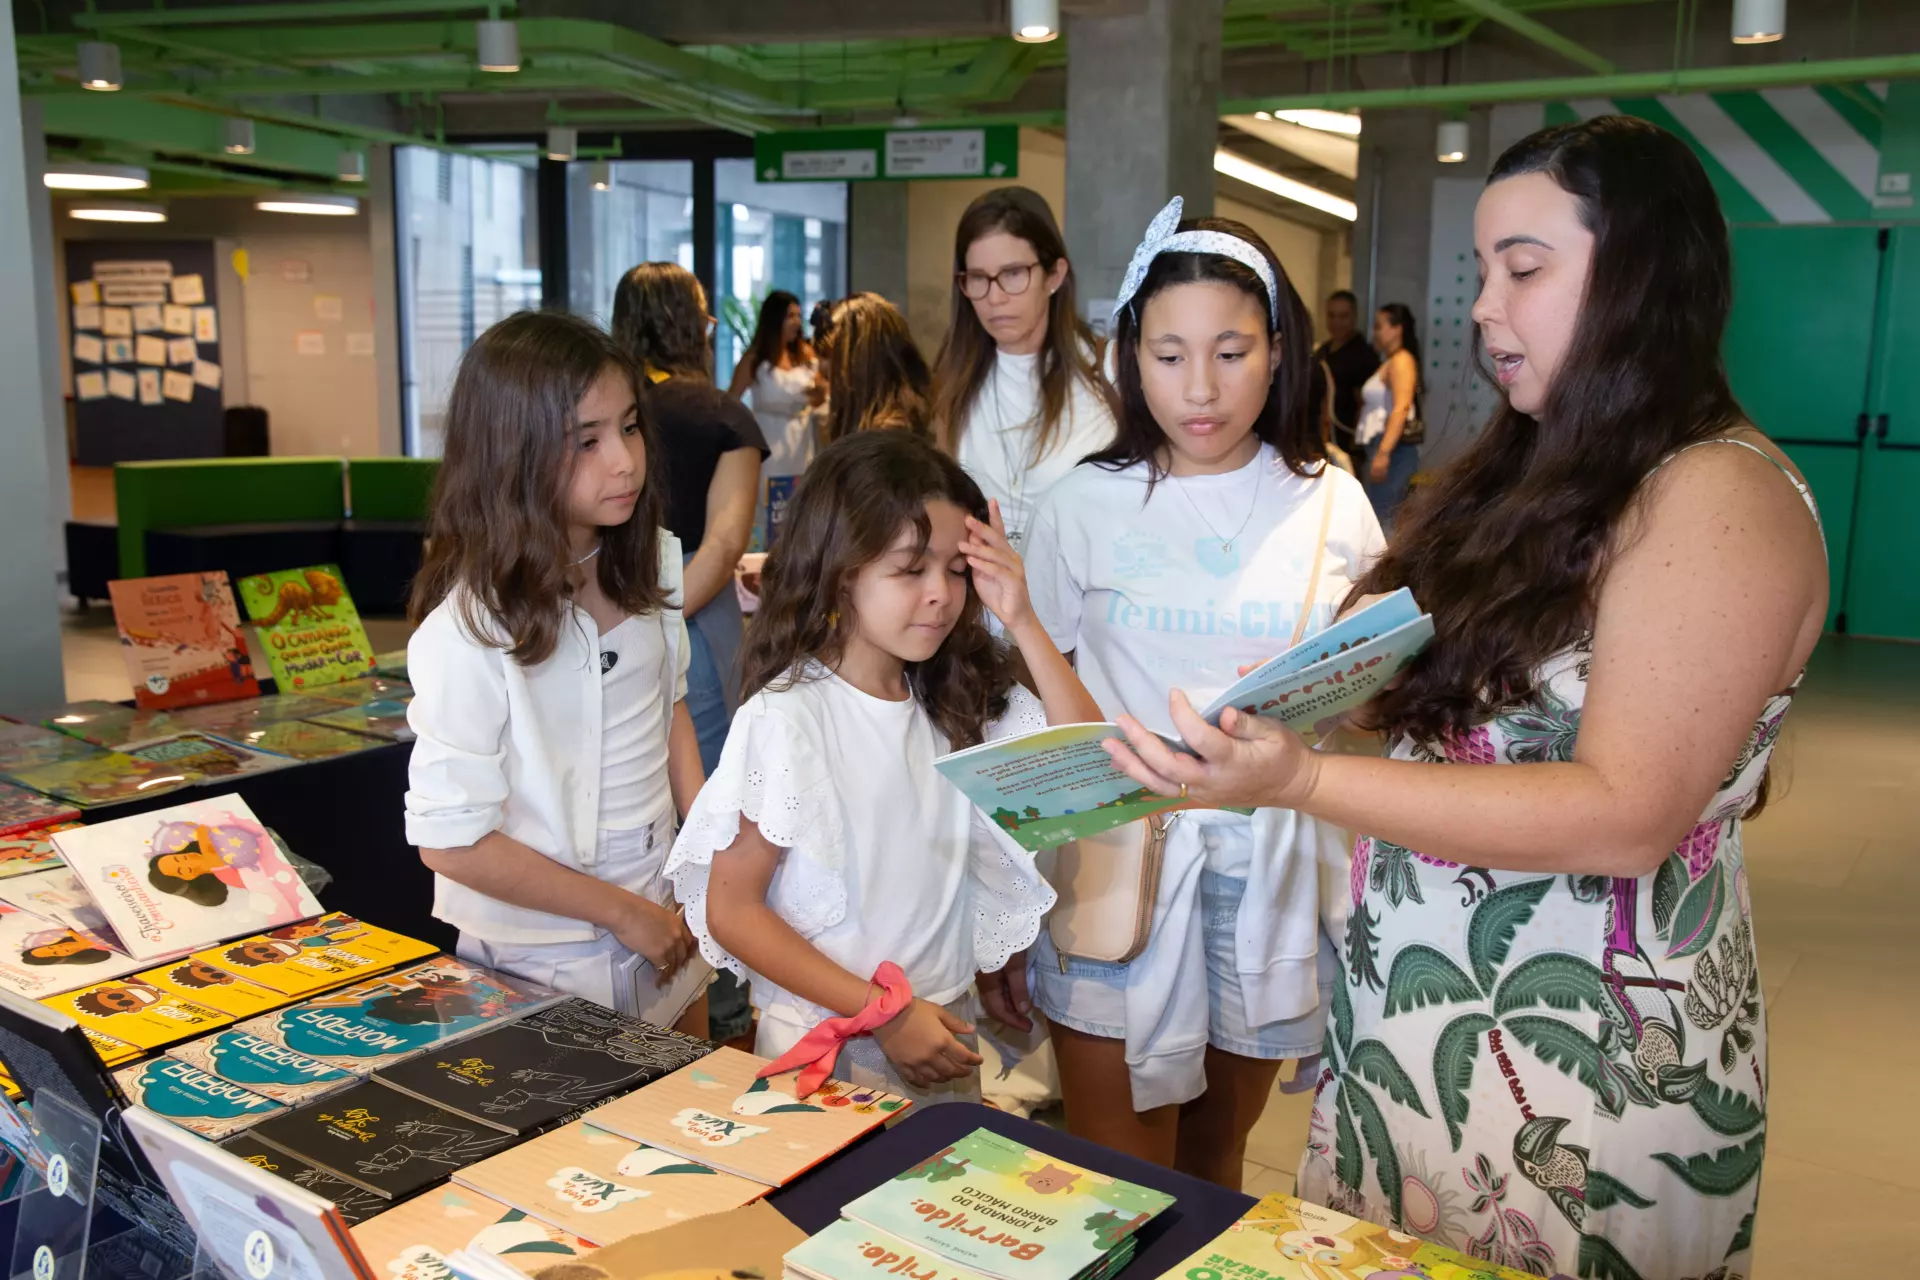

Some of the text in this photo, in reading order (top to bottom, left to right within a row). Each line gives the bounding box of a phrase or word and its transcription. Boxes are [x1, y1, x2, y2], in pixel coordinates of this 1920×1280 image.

[1280, 673, 1373, 717] JORNADA DO
[1280, 704, 1318, 722] ARRO
[115, 883, 161, 940] Travesseiro
[119, 866, 174, 930] Companheiro
[297, 1010, 408, 1050] MORADA
[230, 1034, 336, 1078] MORADA
[161, 1062, 269, 1110] MORADA
[688, 1126, 724, 1142] O voo
[563, 1189, 599, 1207] O voo
[951, 1195, 1045, 1233] A JORNADA DO
[961, 1186, 1058, 1226] BARRO MÁGICO
[910, 1199, 1045, 1260] Barrildo:
[858, 1242, 938, 1280] rildo:
[1206, 1253, 1272, 1280] ERAR
